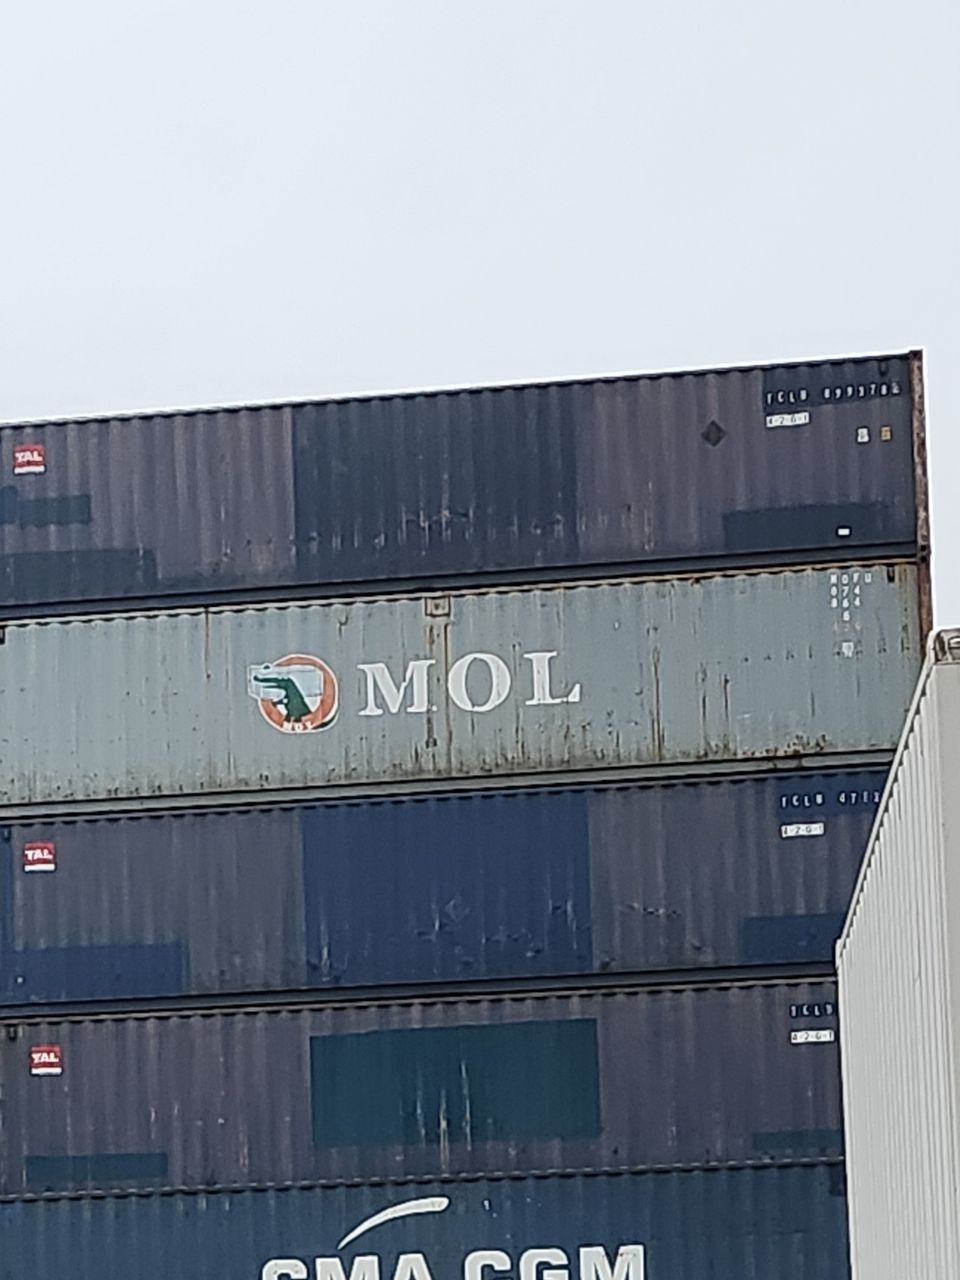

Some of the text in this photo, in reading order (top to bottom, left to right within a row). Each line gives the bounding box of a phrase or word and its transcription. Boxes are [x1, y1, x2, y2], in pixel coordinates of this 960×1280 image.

[357, 651, 581, 716] MOL
[24, 848, 54, 861] TAL
[31, 1052, 60, 1064] TAL
